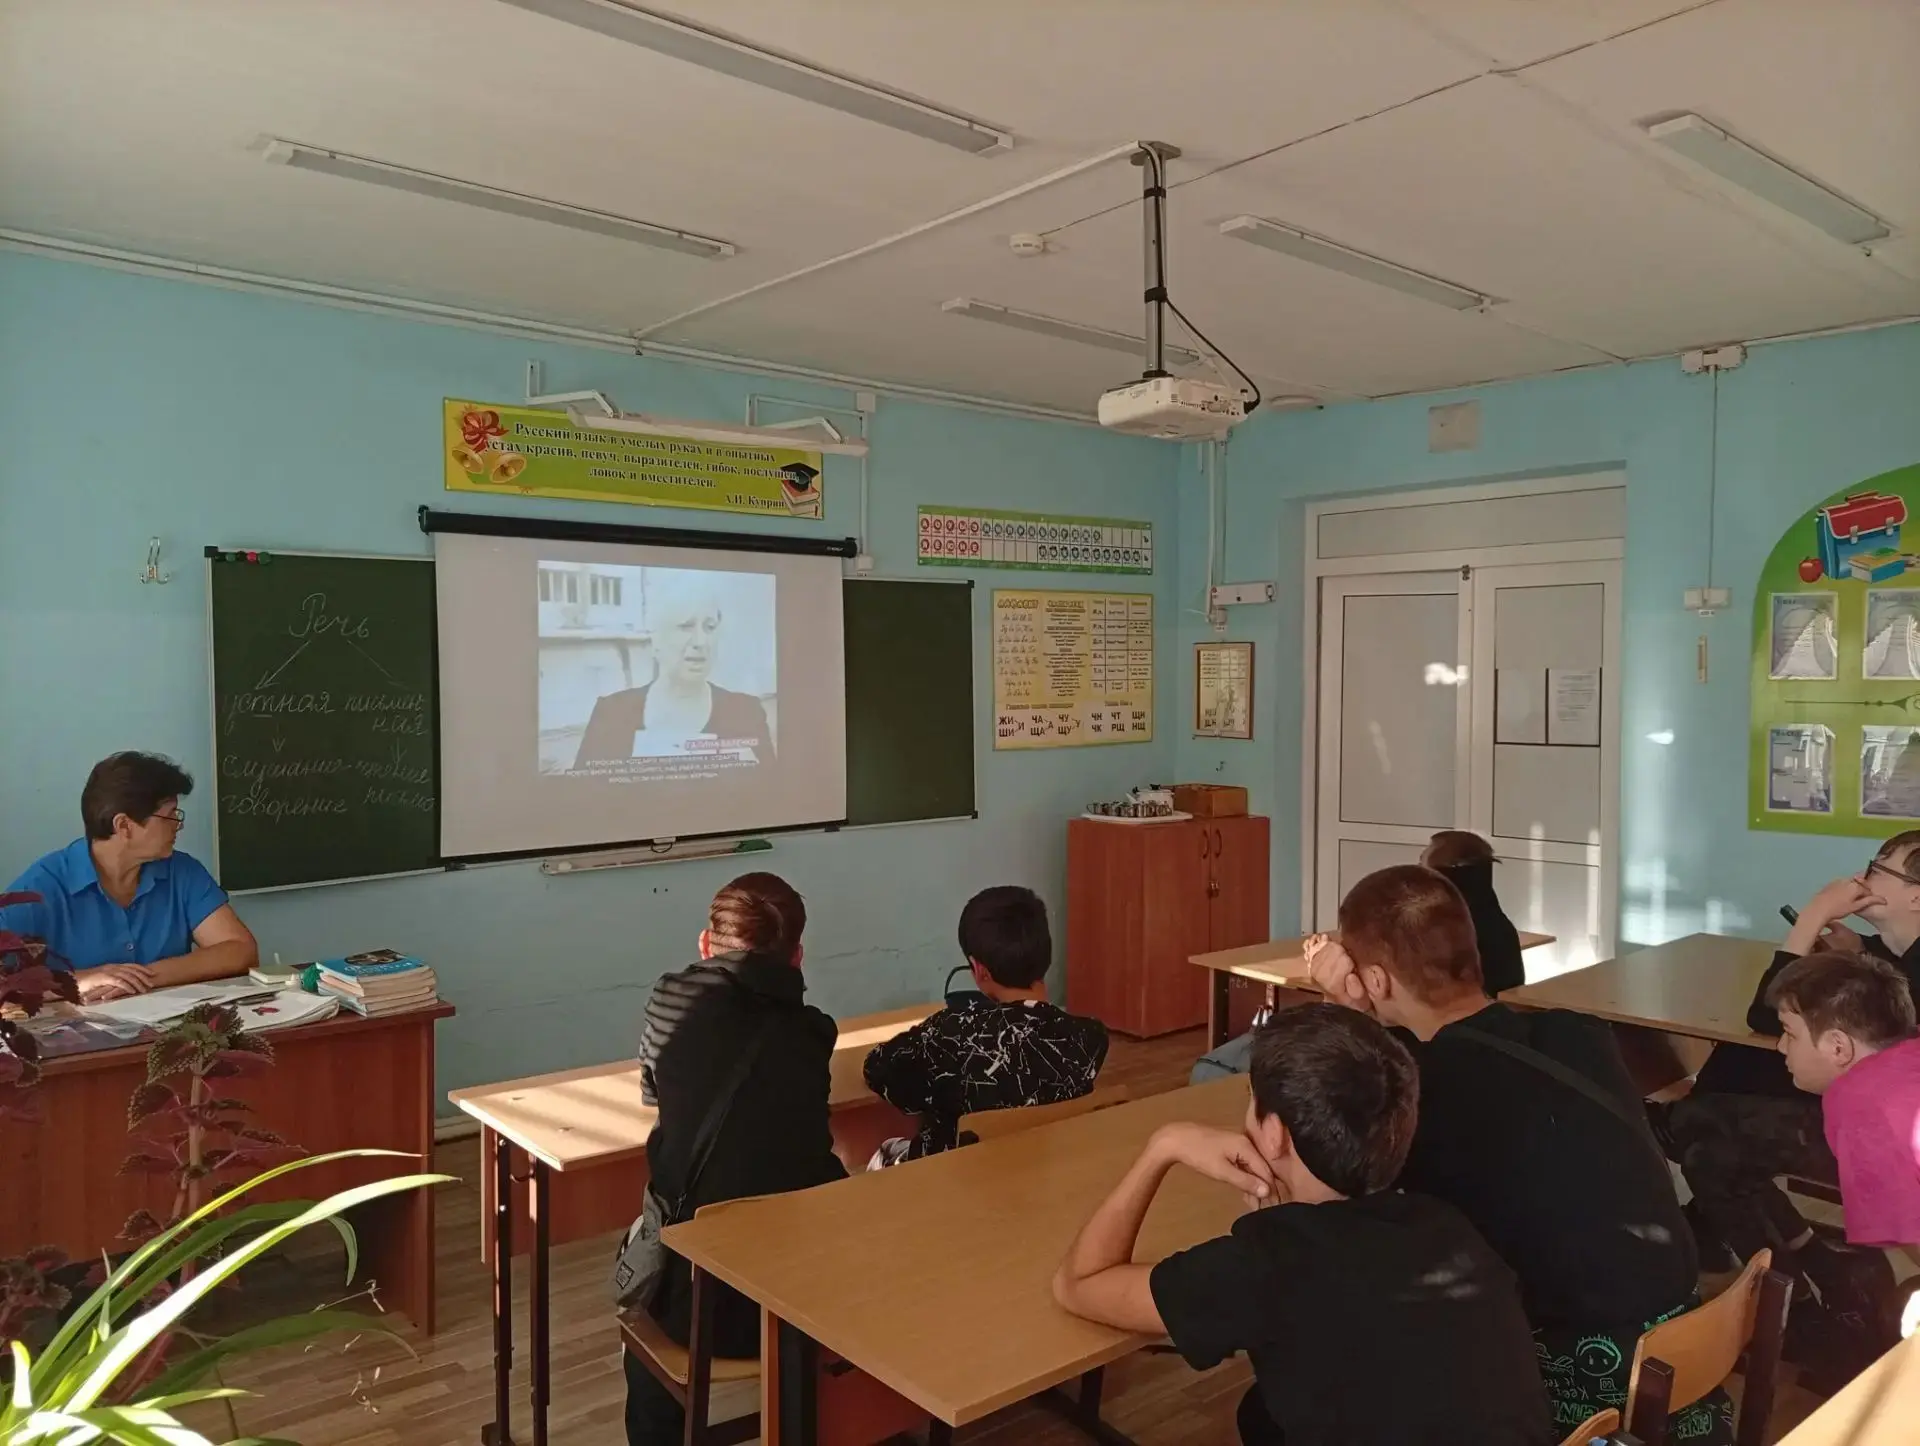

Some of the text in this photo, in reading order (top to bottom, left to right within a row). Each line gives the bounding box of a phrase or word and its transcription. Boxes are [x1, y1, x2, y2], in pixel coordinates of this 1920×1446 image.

[515, 422, 571, 439] Русский
[574, 432, 608, 444] язык
[610, 436, 618, 444] в
[620, 436, 666, 450] умелых
[669, 442, 702, 455] руках
[706, 447, 713, 455] и
[725, 450, 776, 462] опытных
[526, 444, 577, 458] красив,
[581, 449, 620, 462] певуч,
[624, 453, 703, 471] выразителен,
[589, 466, 717, 488] ловок и вместителен.
[288, 592, 369, 638] Речь
[998, 715, 1014, 725] ЖИ
[1031, 714, 1044, 724] ЧА
[1058, 714, 1070, 723] ЧУ
[1110, 711, 1121, 720] ЧТ
[998, 727, 1015, 738] ШИ
[1030, 726, 1046, 737] ЩА
[1057, 725, 1073, 736] ЩУ
[1111, 723, 1125, 732] РЩ
